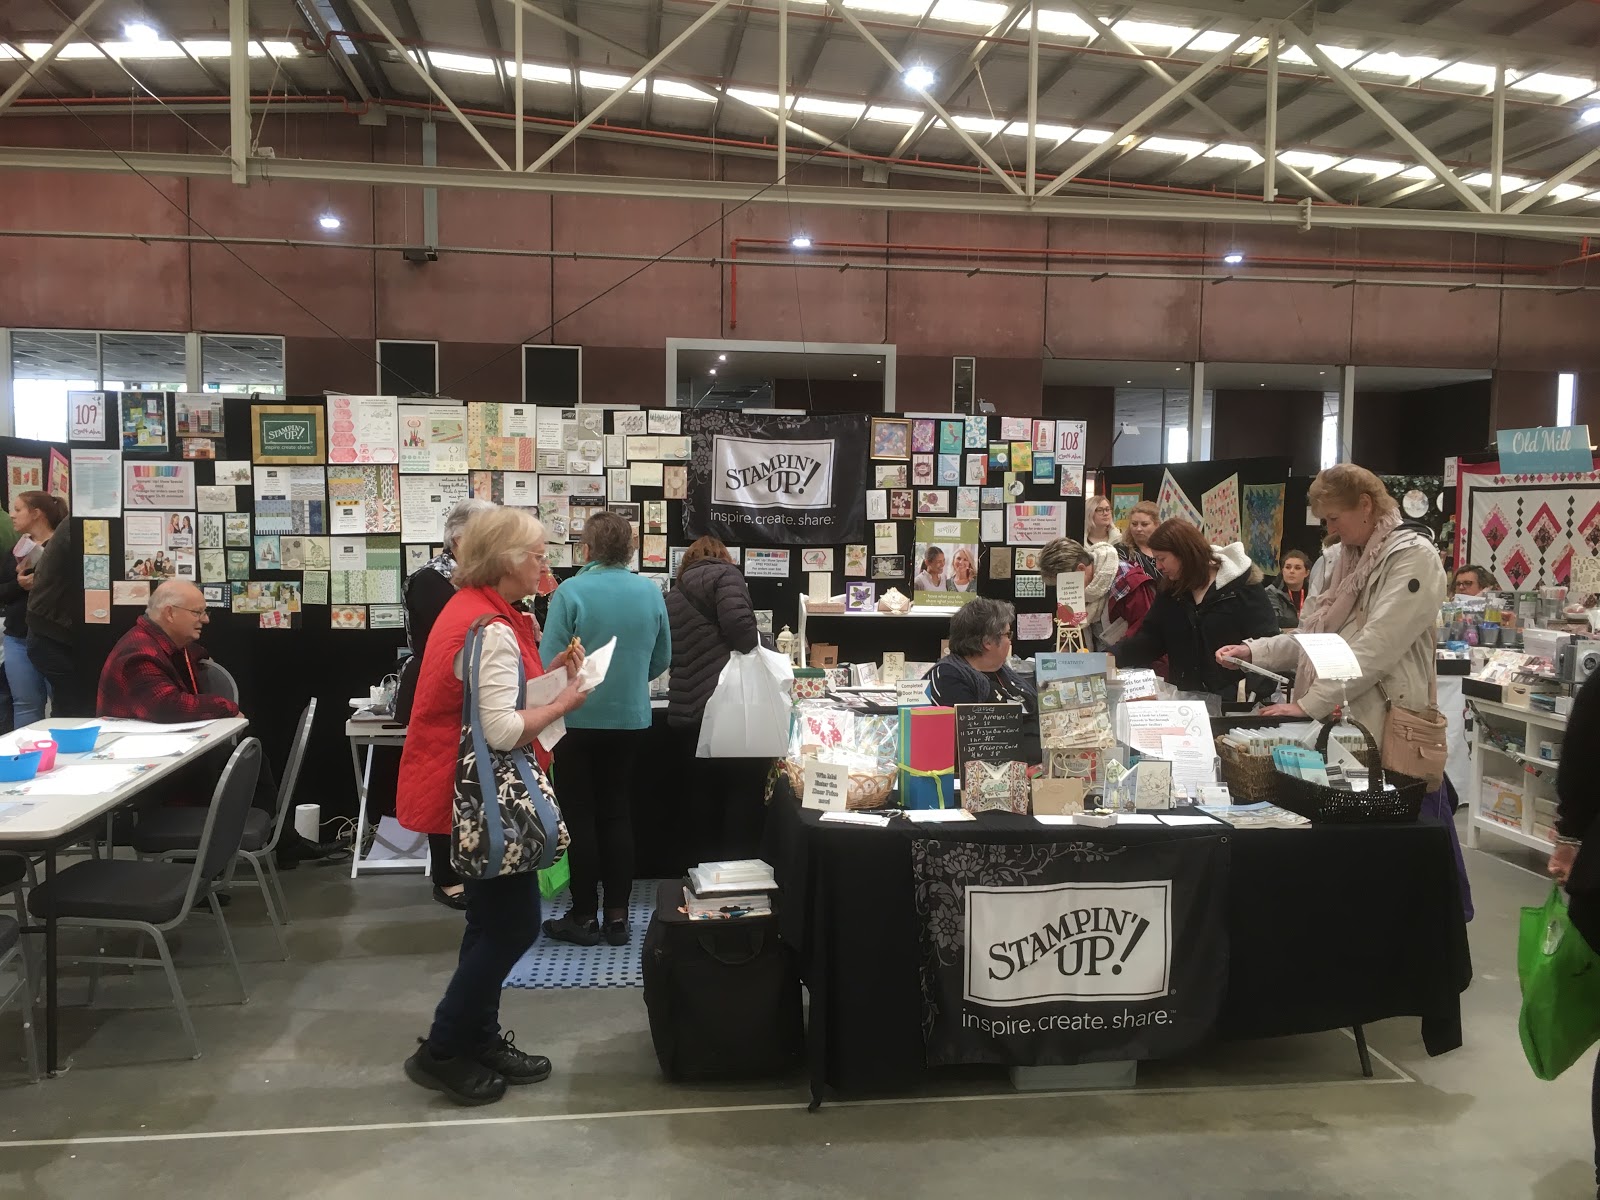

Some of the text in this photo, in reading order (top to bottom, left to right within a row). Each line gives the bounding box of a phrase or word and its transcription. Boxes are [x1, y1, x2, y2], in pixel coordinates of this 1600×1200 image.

[75, 404, 97, 424] 109
[268, 425, 303, 439] STAMPIN'
[284, 427, 305, 440] UP!
[1061, 432, 1079, 450] 108
[1512, 429, 1572, 454] Old Mill
[725, 454, 815, 490] STAMPIN'
[766, 461, 822, 495] UP!
[825, 789, 839, 797] Prize
[988, 907, 1138, 981] STAMPIN'
[1053, 917, 1150, 976] UP!
